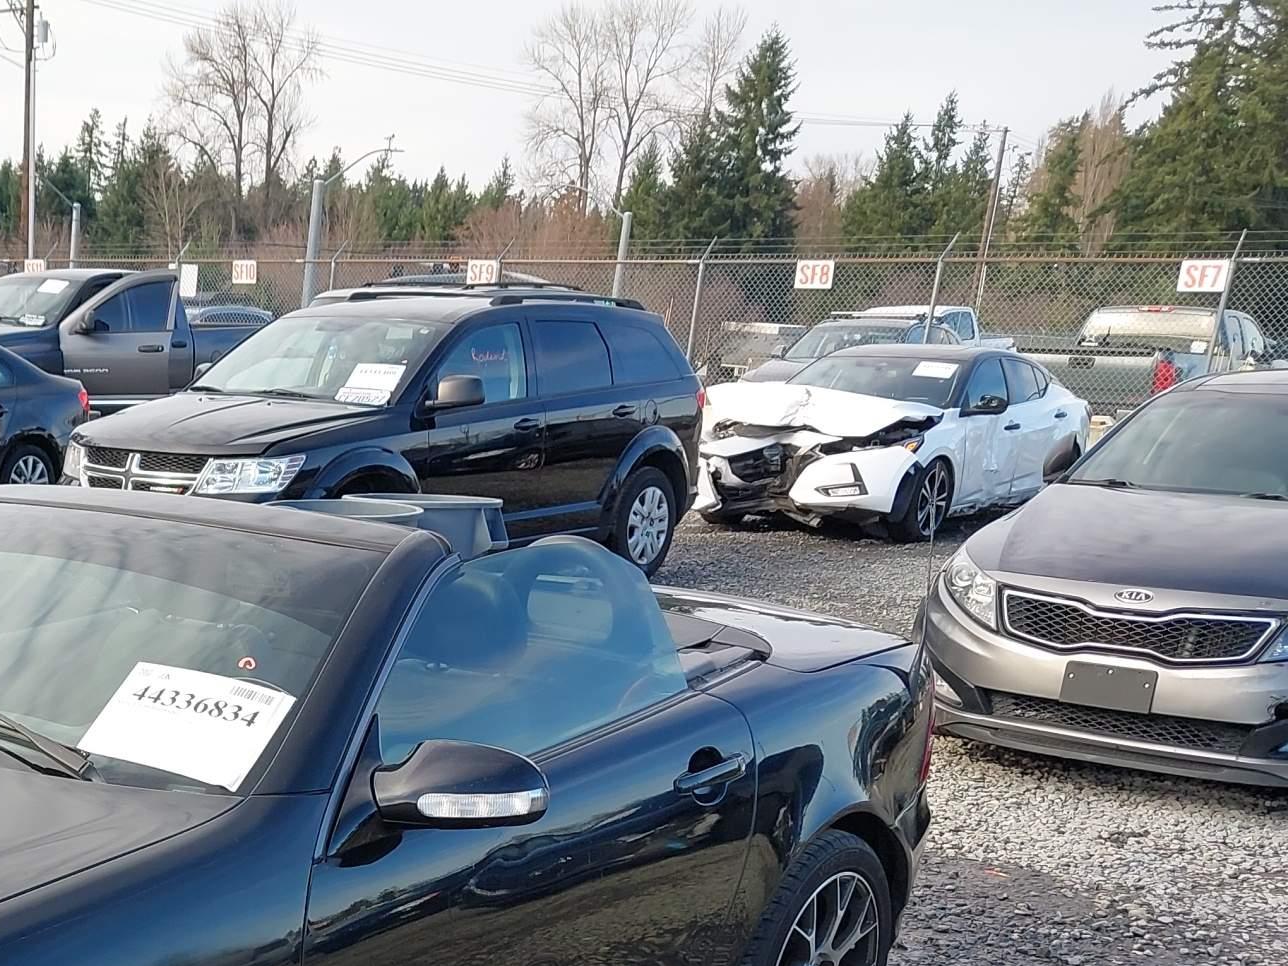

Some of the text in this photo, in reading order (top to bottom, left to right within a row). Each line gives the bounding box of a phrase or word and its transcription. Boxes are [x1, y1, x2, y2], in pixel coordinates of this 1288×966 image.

[233, 263, 256, 281] SF10
[470, 263, 494, 282] SF9
[799, 264, 830, 285] SF8
[1183, 264, 1223, 288] SF7
[1120, 591, 1147, 601] KIA
[132, 685, 261, 728] 44336834
